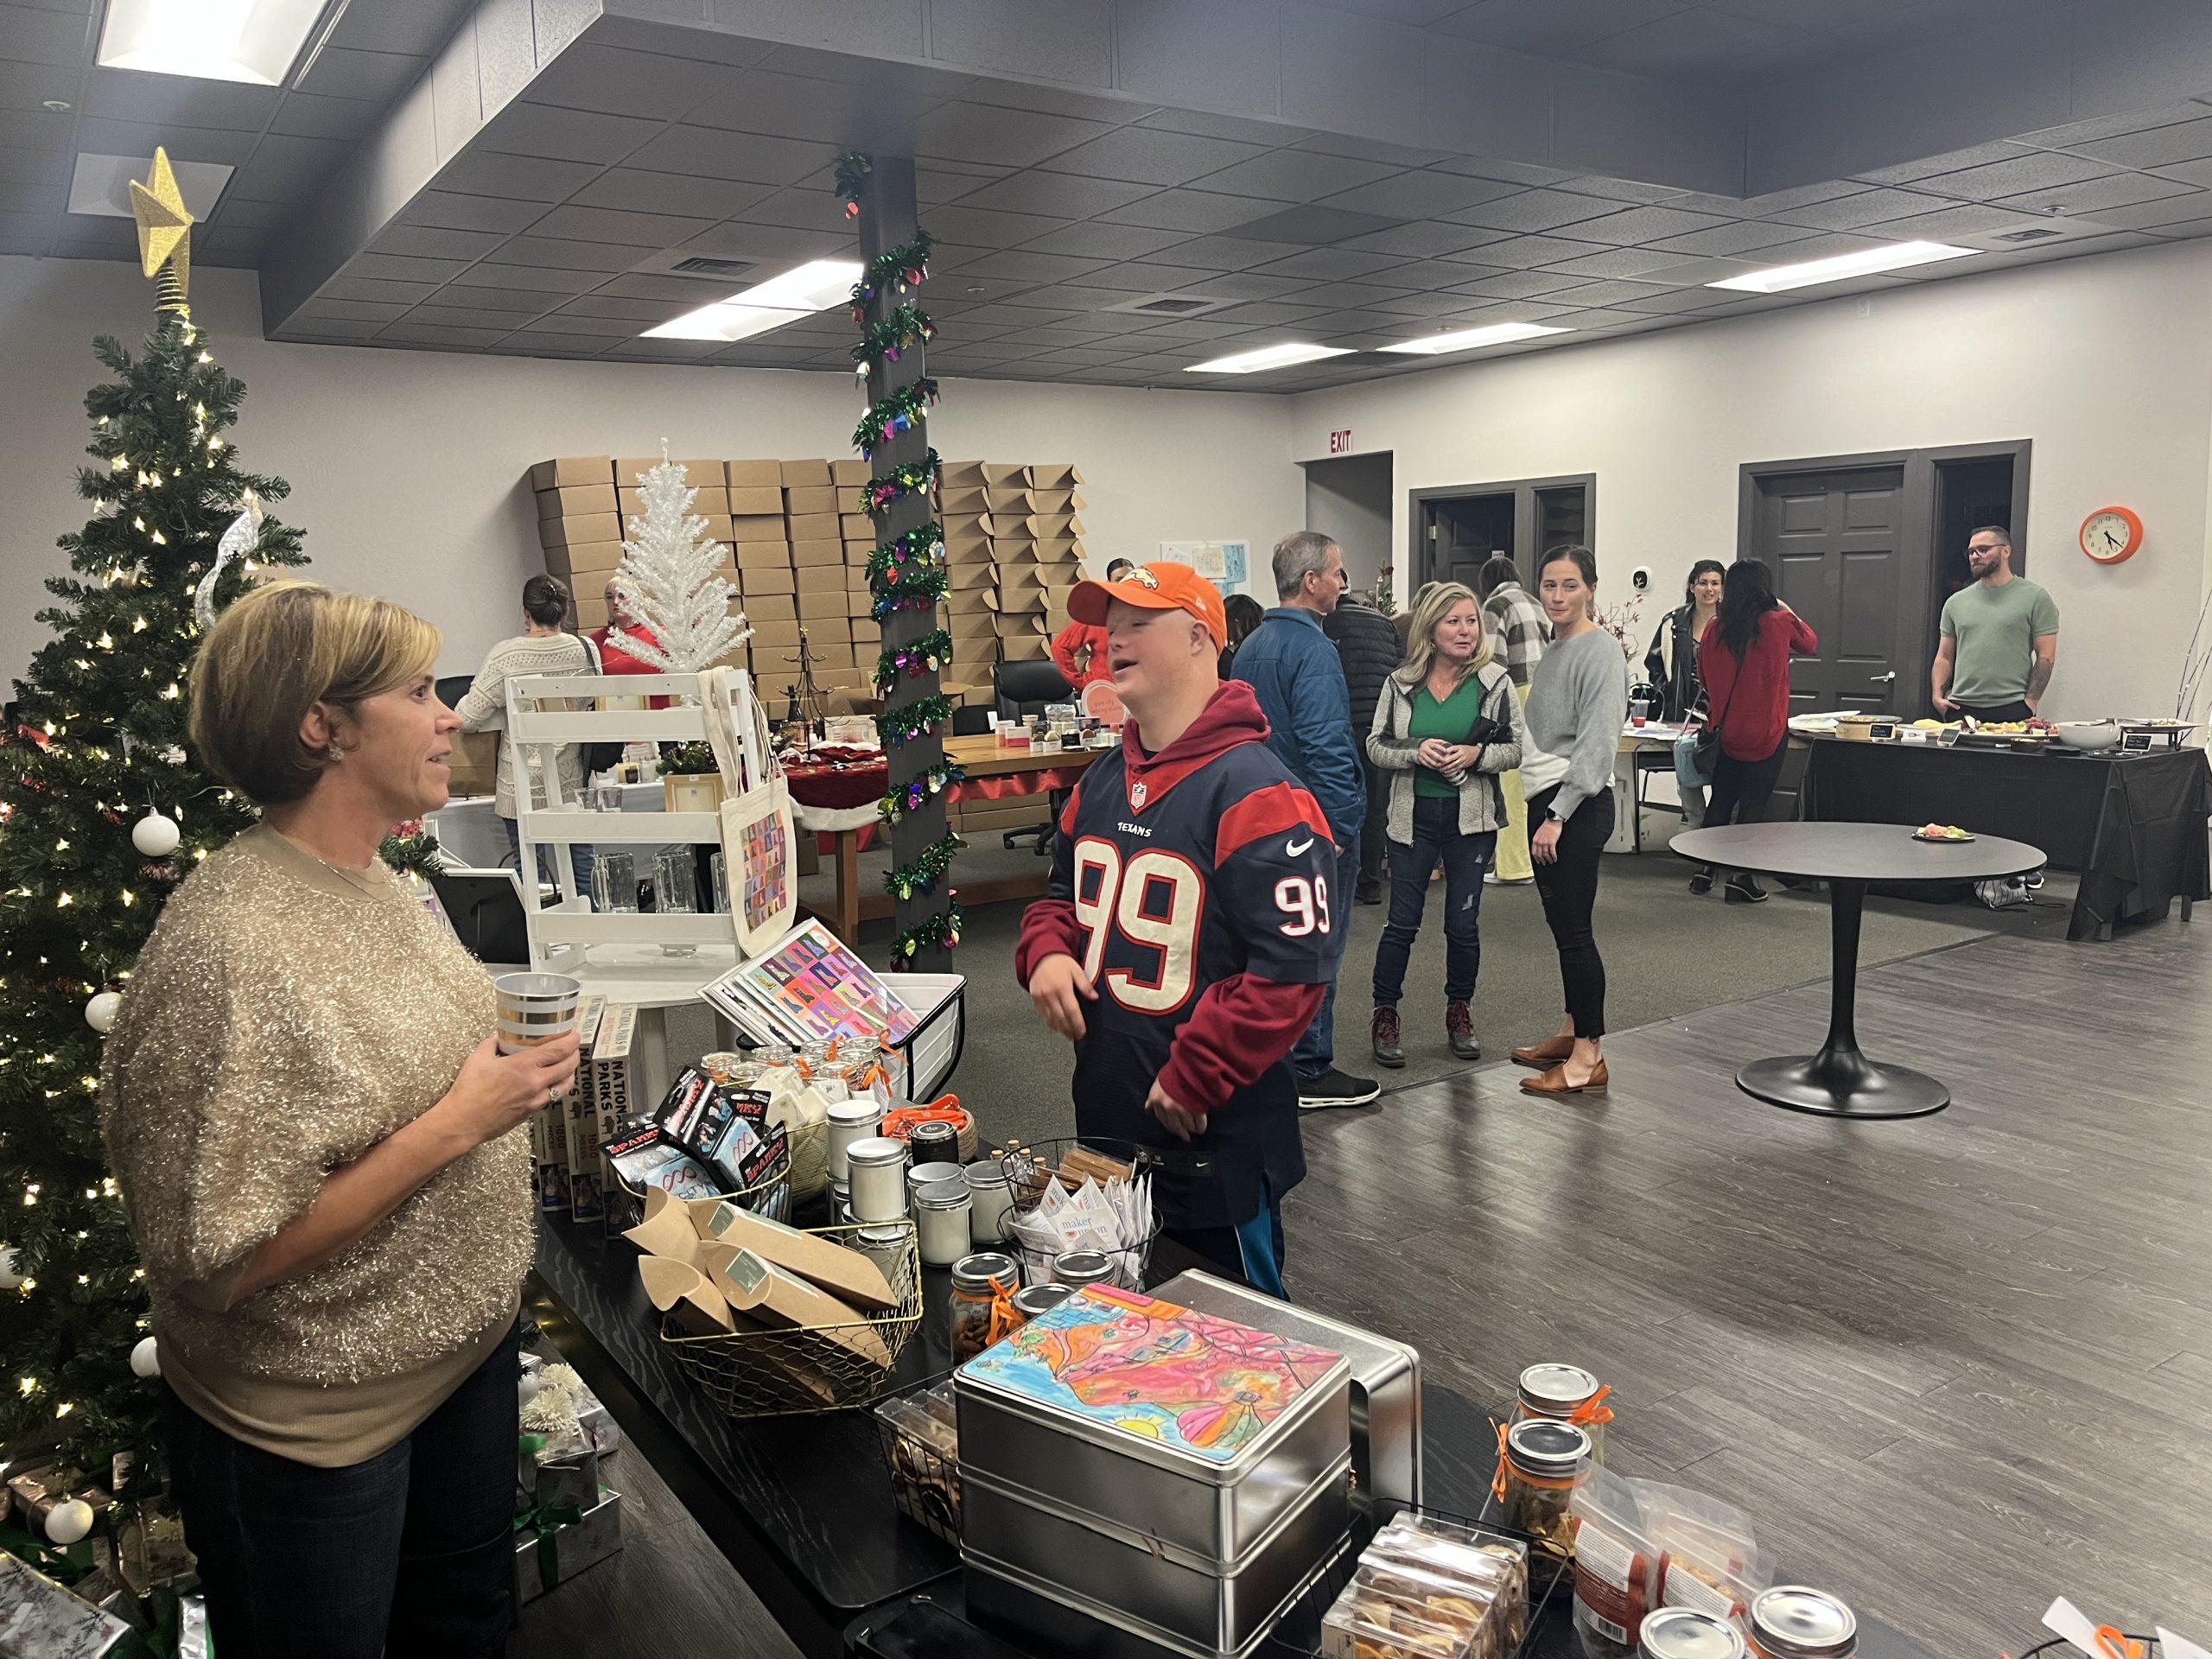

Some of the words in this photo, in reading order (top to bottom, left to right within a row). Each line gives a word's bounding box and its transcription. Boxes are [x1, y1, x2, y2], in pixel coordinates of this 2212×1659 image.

[1331, 429, 1351, 454] EXIT
[1117, 822, 1152, 836] TEXANS
[1074, 835, 1205, 1015] 99
[1274, 874, 1332, 938] 99
[579, 1047, 595, 1119] NATIONAL
[598, 1062, 612, 1111] PARKS
[1062, 1217, 1092, 1229] maker
